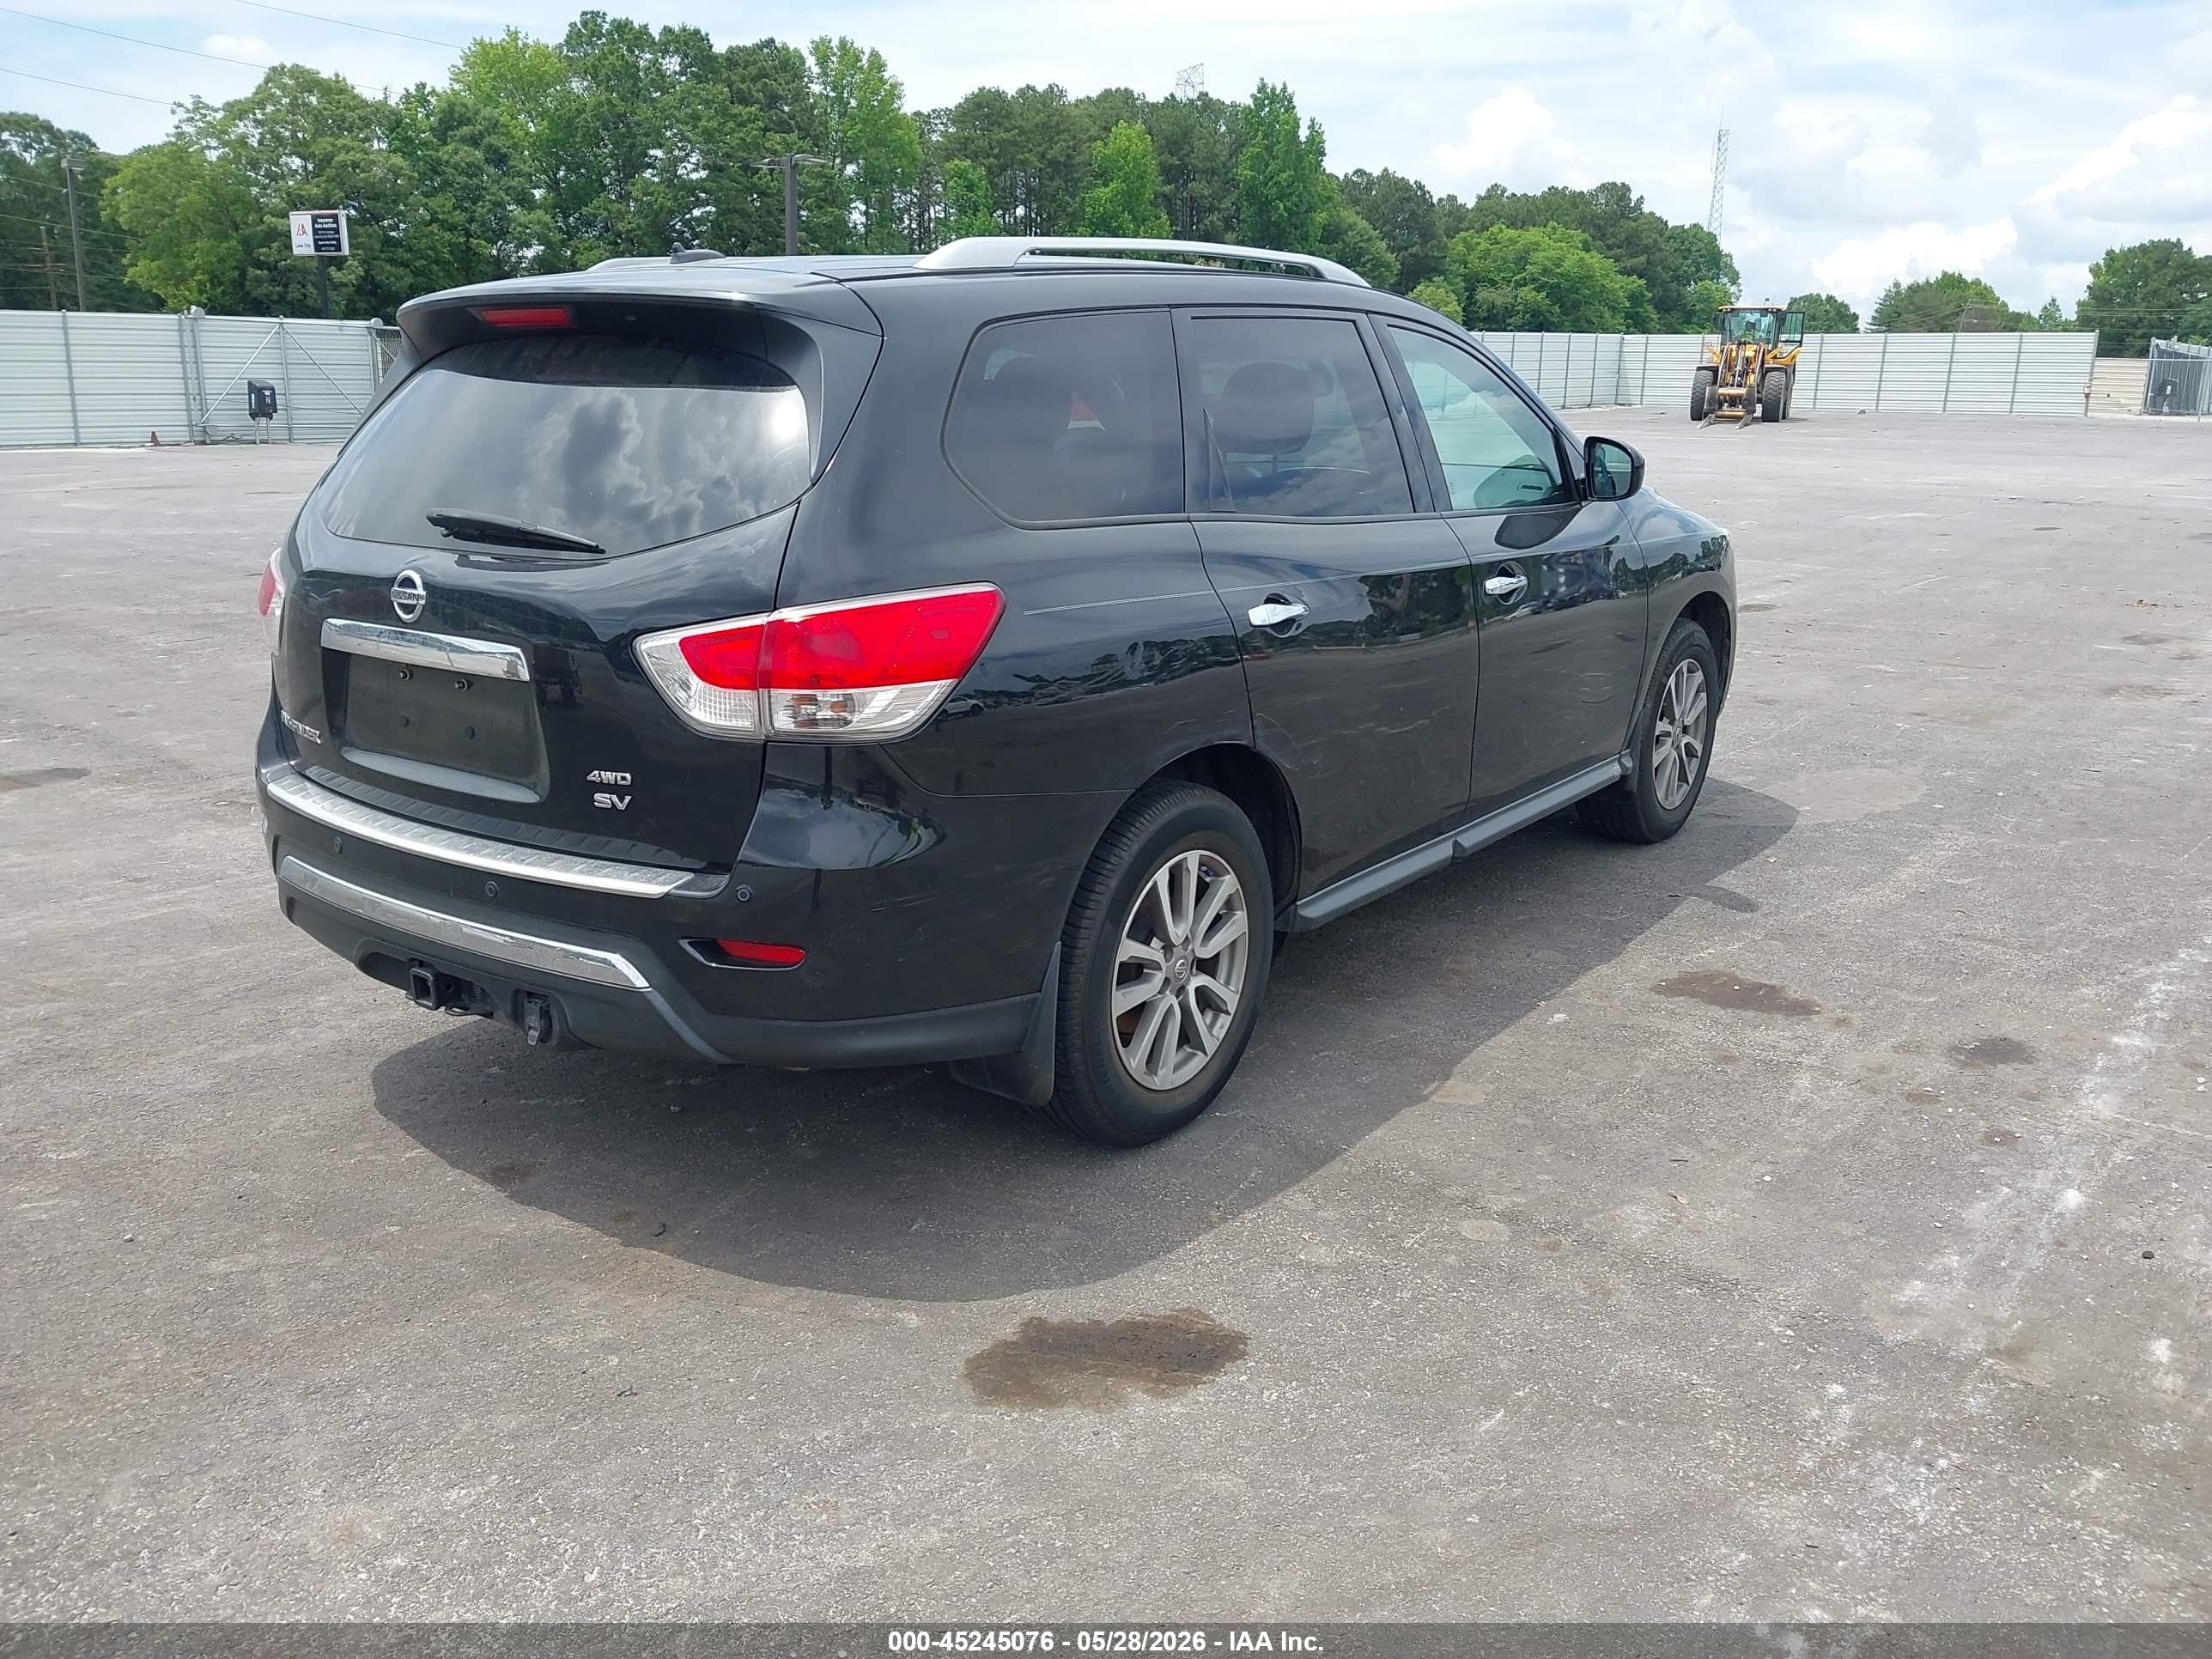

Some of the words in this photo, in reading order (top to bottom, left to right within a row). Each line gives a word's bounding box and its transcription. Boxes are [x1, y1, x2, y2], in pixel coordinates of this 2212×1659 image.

[392, 590, 419, 602] NISSAN
[586, 770, 631, 785] 4WD
[593, 793, 632, 811] SV
